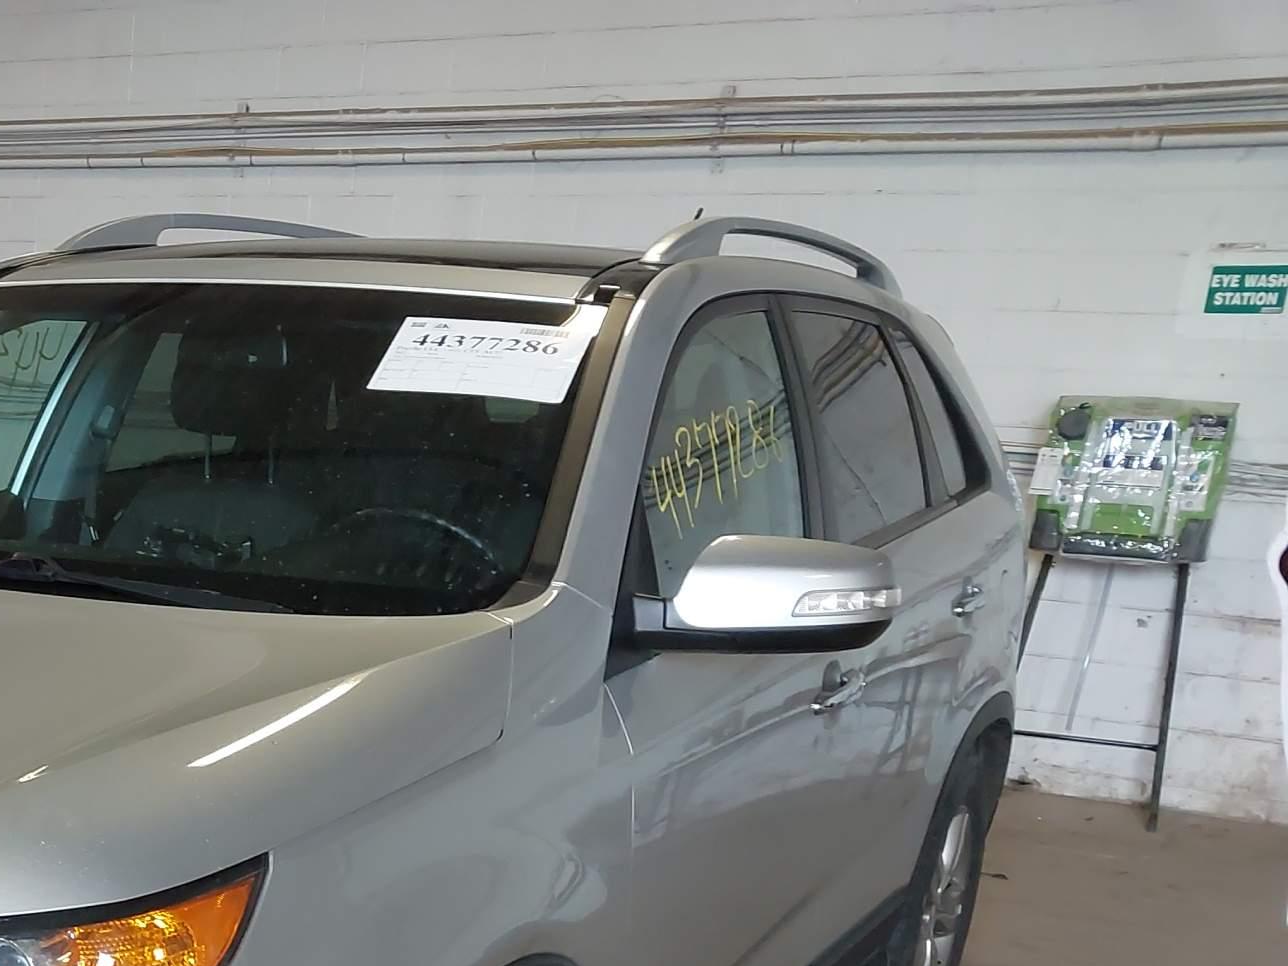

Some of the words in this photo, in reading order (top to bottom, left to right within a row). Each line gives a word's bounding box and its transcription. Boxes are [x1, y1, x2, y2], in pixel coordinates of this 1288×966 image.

[1211, 273, 1242, 288] EYE
[1213, 291, 1280, 305] STATION
[411, 333, 562, 356] 44377286
